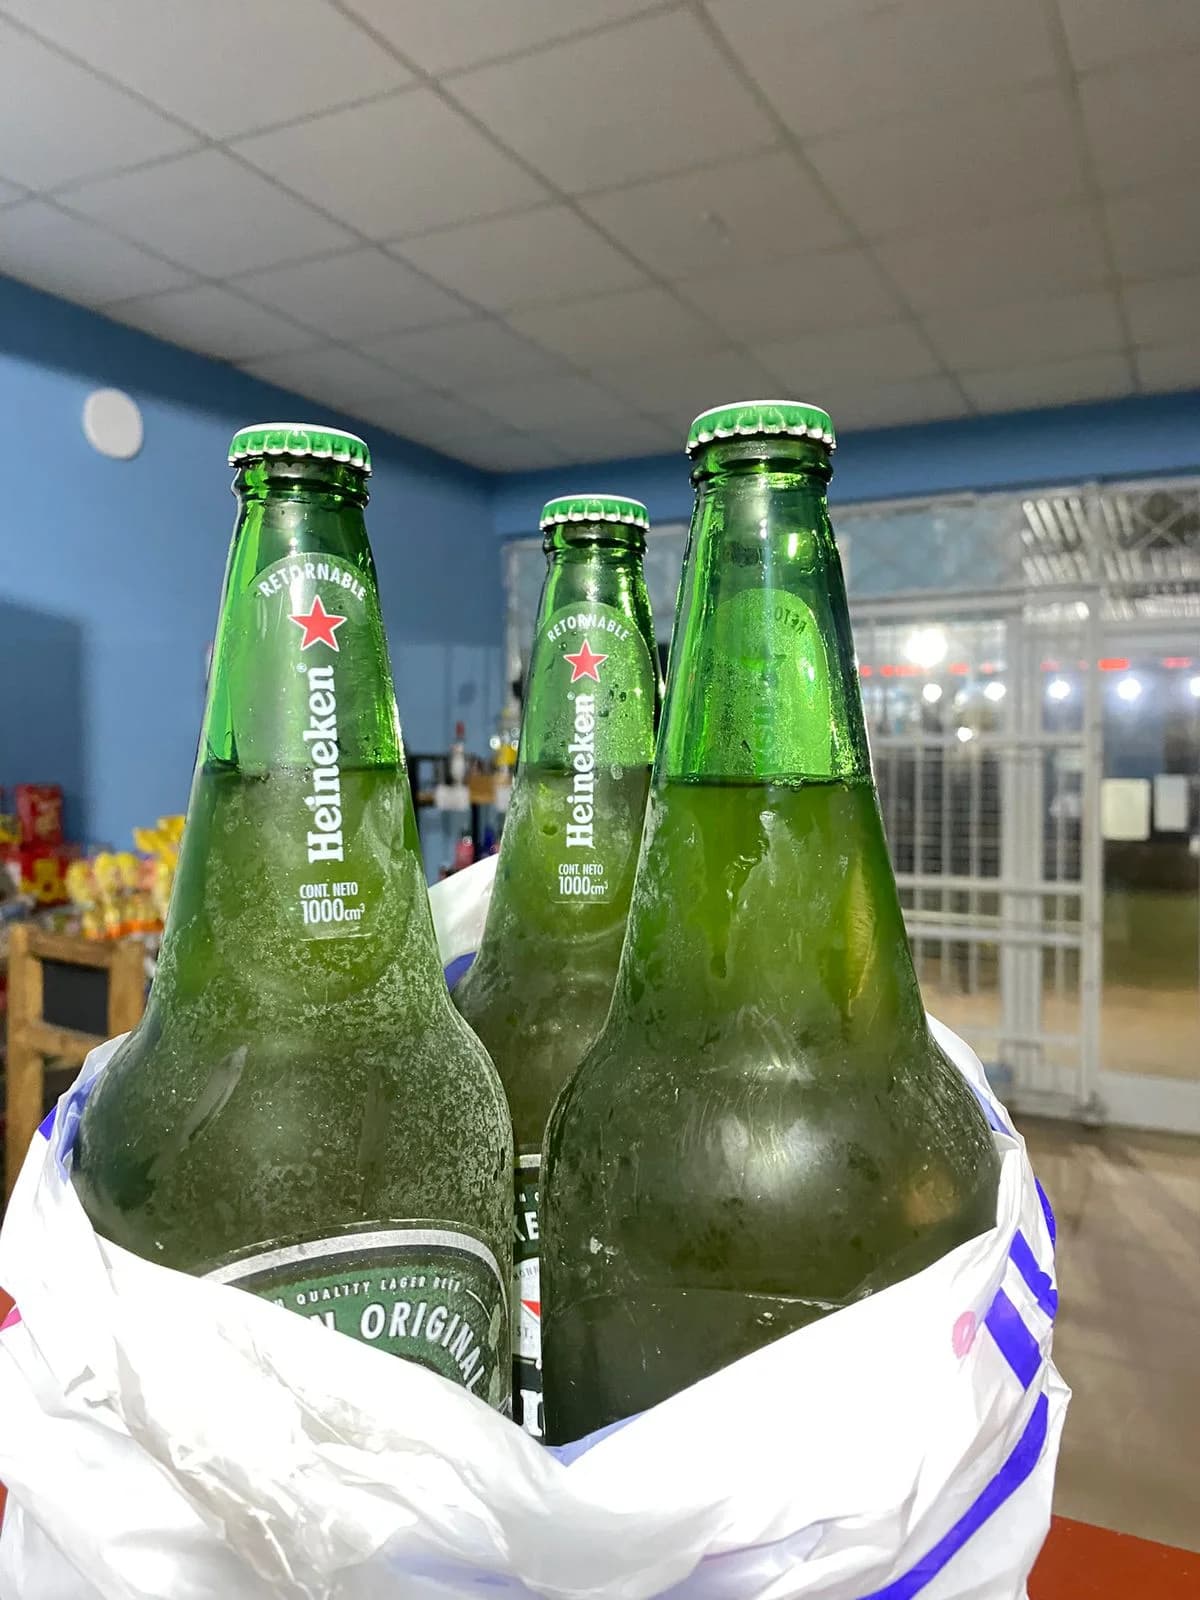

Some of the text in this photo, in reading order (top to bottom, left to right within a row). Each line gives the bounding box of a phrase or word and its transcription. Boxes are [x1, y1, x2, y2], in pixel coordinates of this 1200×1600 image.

[259, 563, 367, 600] RETORNABLE
[547, 613, 629, 642] RETORNABLE
[303, 665, 343, 864] Heineken
[566, 693, 595, 849] Heineken
[558, 864, 604, 875] CONT. NETO
[299, 882, 358, 898] CONT. NETO
[296, 1281, 371, 1305] QUALITY
[380, 1275, 426, 1292] LAGER
[433, 1276, 461, 1292] BEER
[360, 1301, 485, 1392] ORIGINAL
